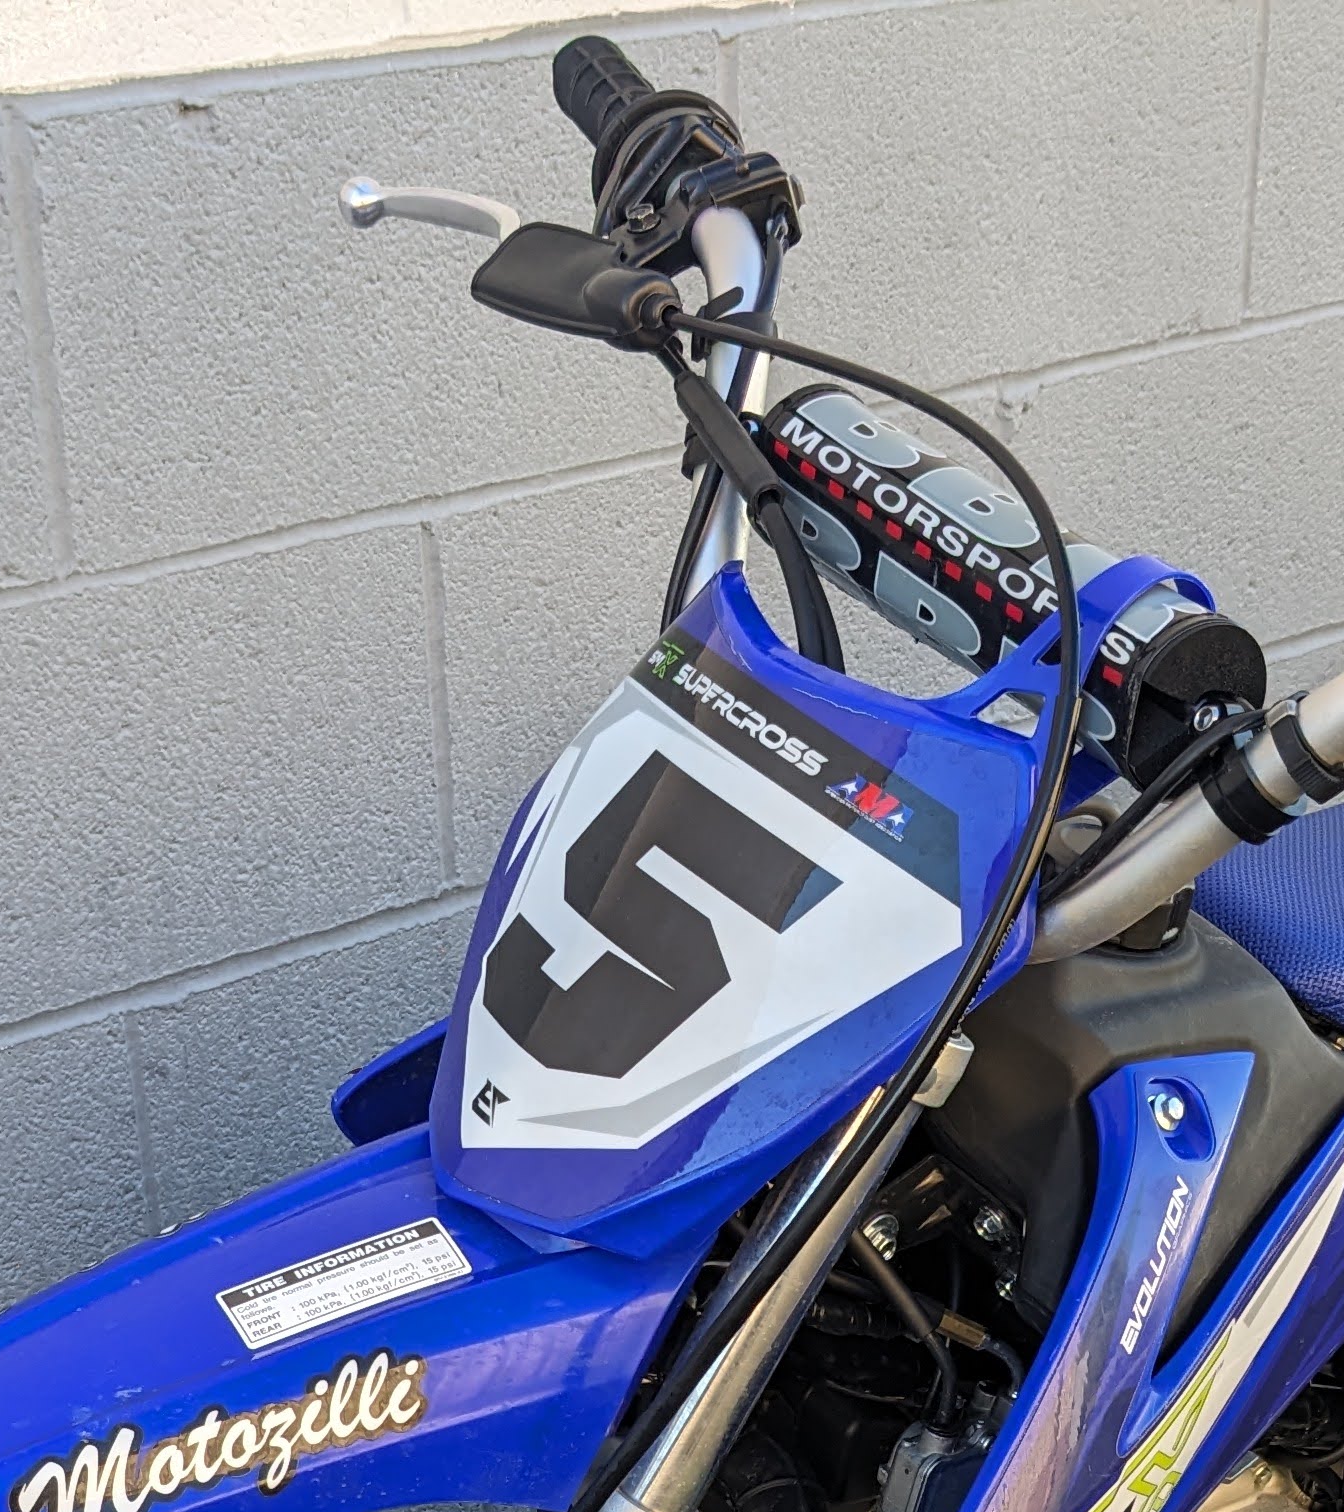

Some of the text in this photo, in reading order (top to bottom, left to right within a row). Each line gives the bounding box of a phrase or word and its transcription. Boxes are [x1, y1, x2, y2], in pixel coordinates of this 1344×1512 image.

[779, 416, 1138, 667] MOTORSPORS
[672, 662, 830, 777] SUPERCROSS
[482, 749, 844, 1079] 5
[236, 1237, 439, 1315] Cold tire normal pressure should be set as
[242, 1228, 421, 1298] TIRE INFORMATION
[246, 1311, 282, 1329] FRONT
[298, 1298, 317, 1310] 100
[343, 1278, 370, 1293] (1.00
[421, 1256, 434, 1266] 15
[434, 1251, 451, 1265] psi
[251, 1322, 283, 1338] REAR
[304, 1307, 322, 1318] 100
[427, 1265, 440, 1275] 15
[440, 1260, 457, 1273] psi
[1119, 1174, 1190, 1355] EVOLUTION
